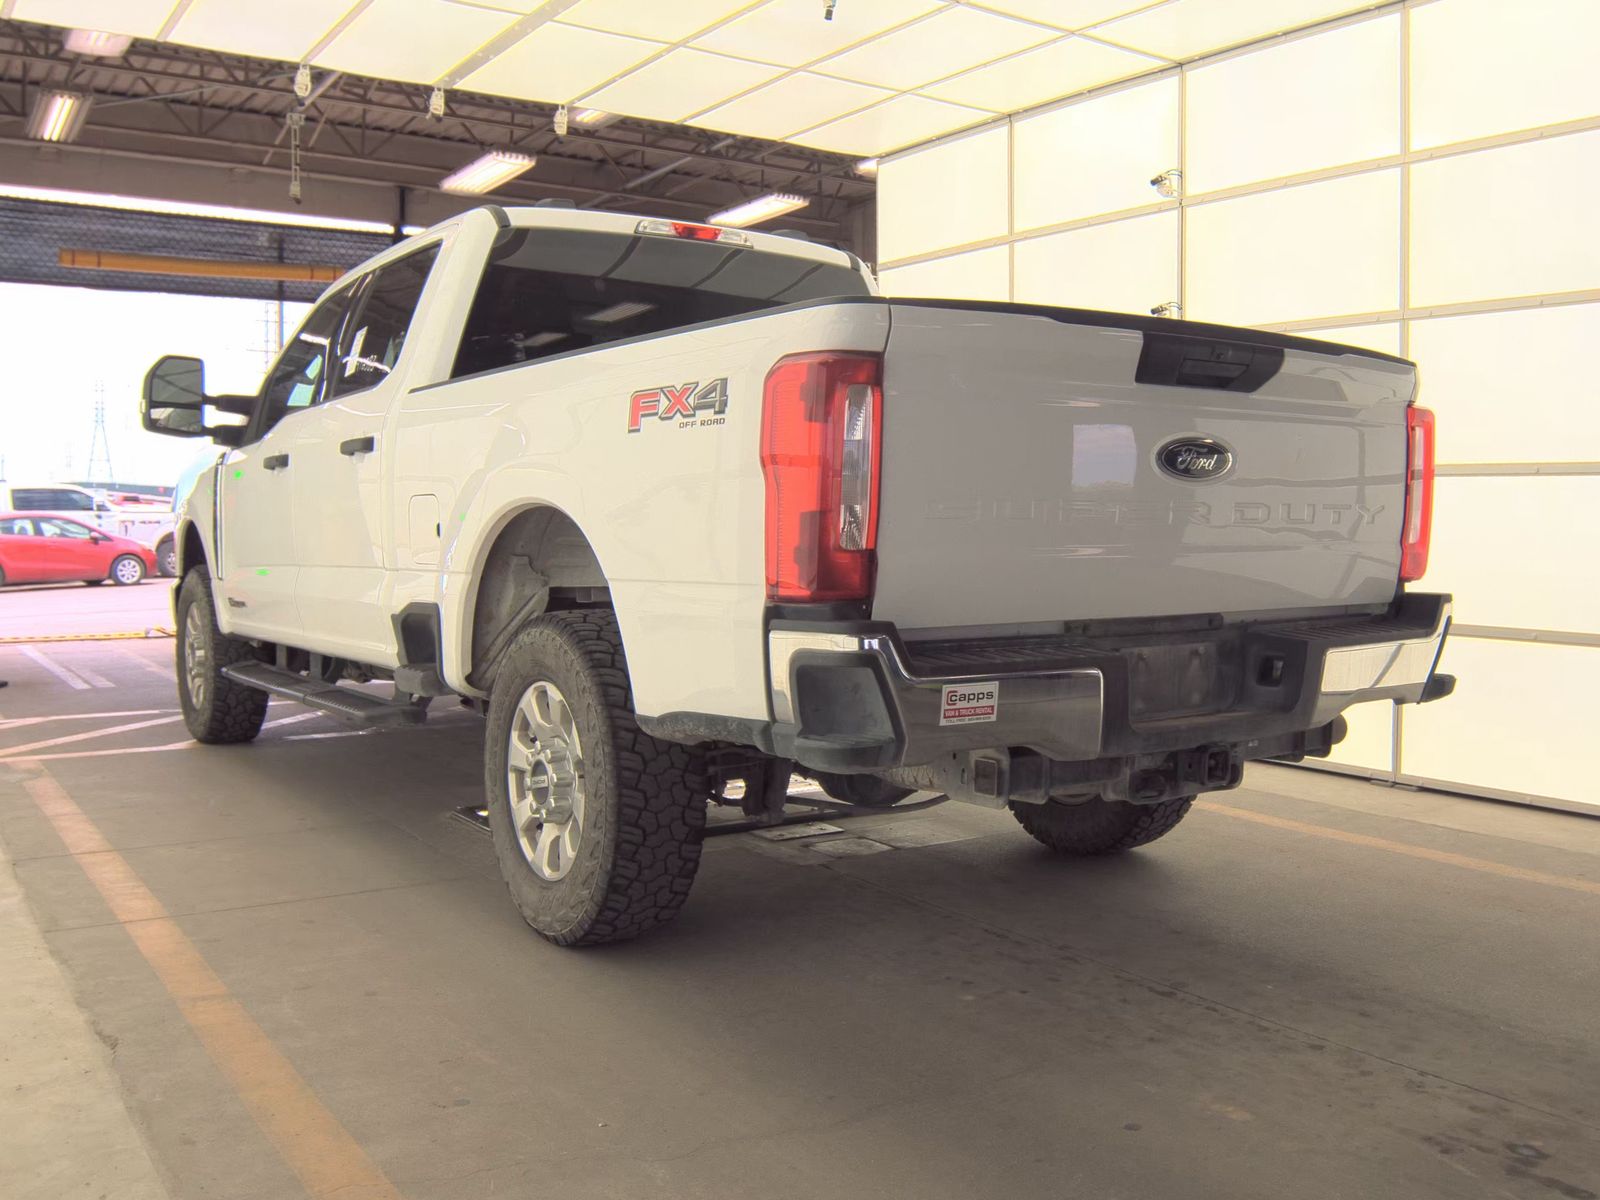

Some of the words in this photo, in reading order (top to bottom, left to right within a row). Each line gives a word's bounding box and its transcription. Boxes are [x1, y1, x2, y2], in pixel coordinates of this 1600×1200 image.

[628, 377, 728, 433] FX4
[679, 420, 697, 429] OFF
[700, 417, 726, 427] ROAD
[1174, 446, 1217, 471] Ford
[1231, 502, 1386, 526] DUTY
